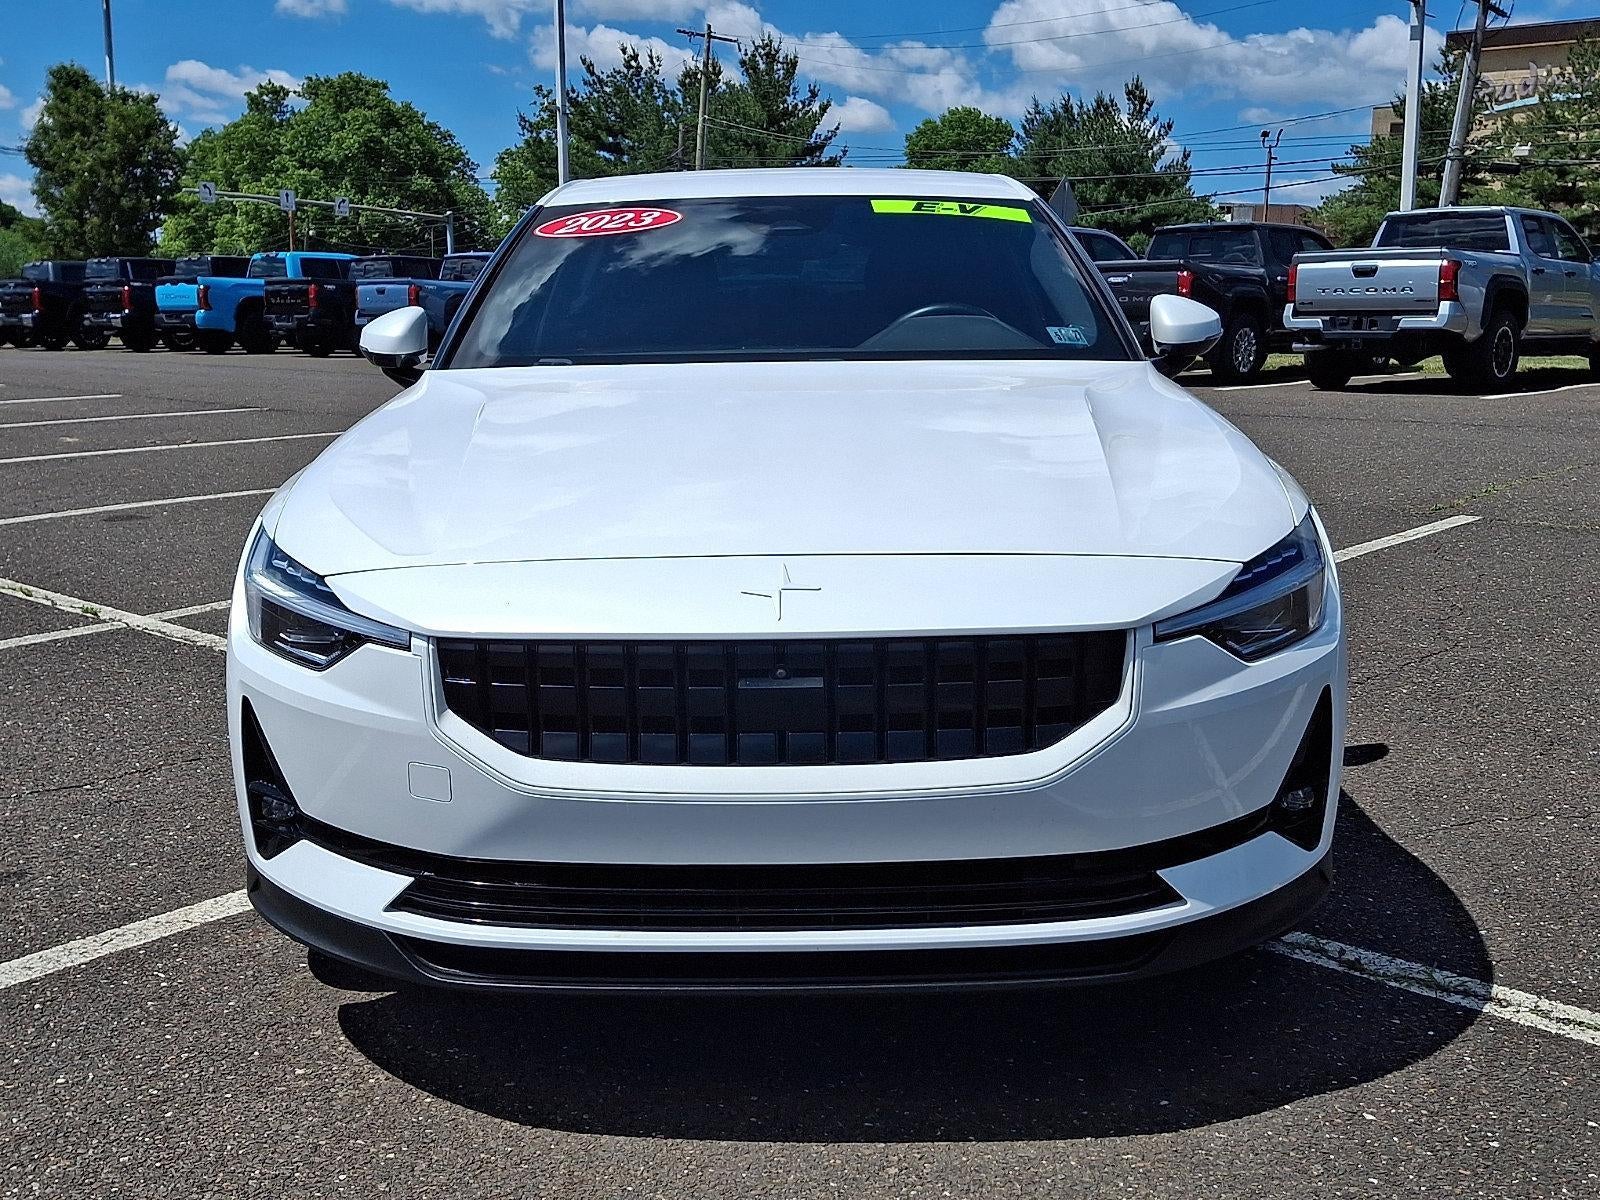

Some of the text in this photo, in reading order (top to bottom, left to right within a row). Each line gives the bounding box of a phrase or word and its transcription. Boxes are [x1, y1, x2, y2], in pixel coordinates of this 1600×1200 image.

[912, 201, 986, 215] E-V
[553, 211, 661, 235] 2023
[1316, 286, 1414, 297] TACOMA
